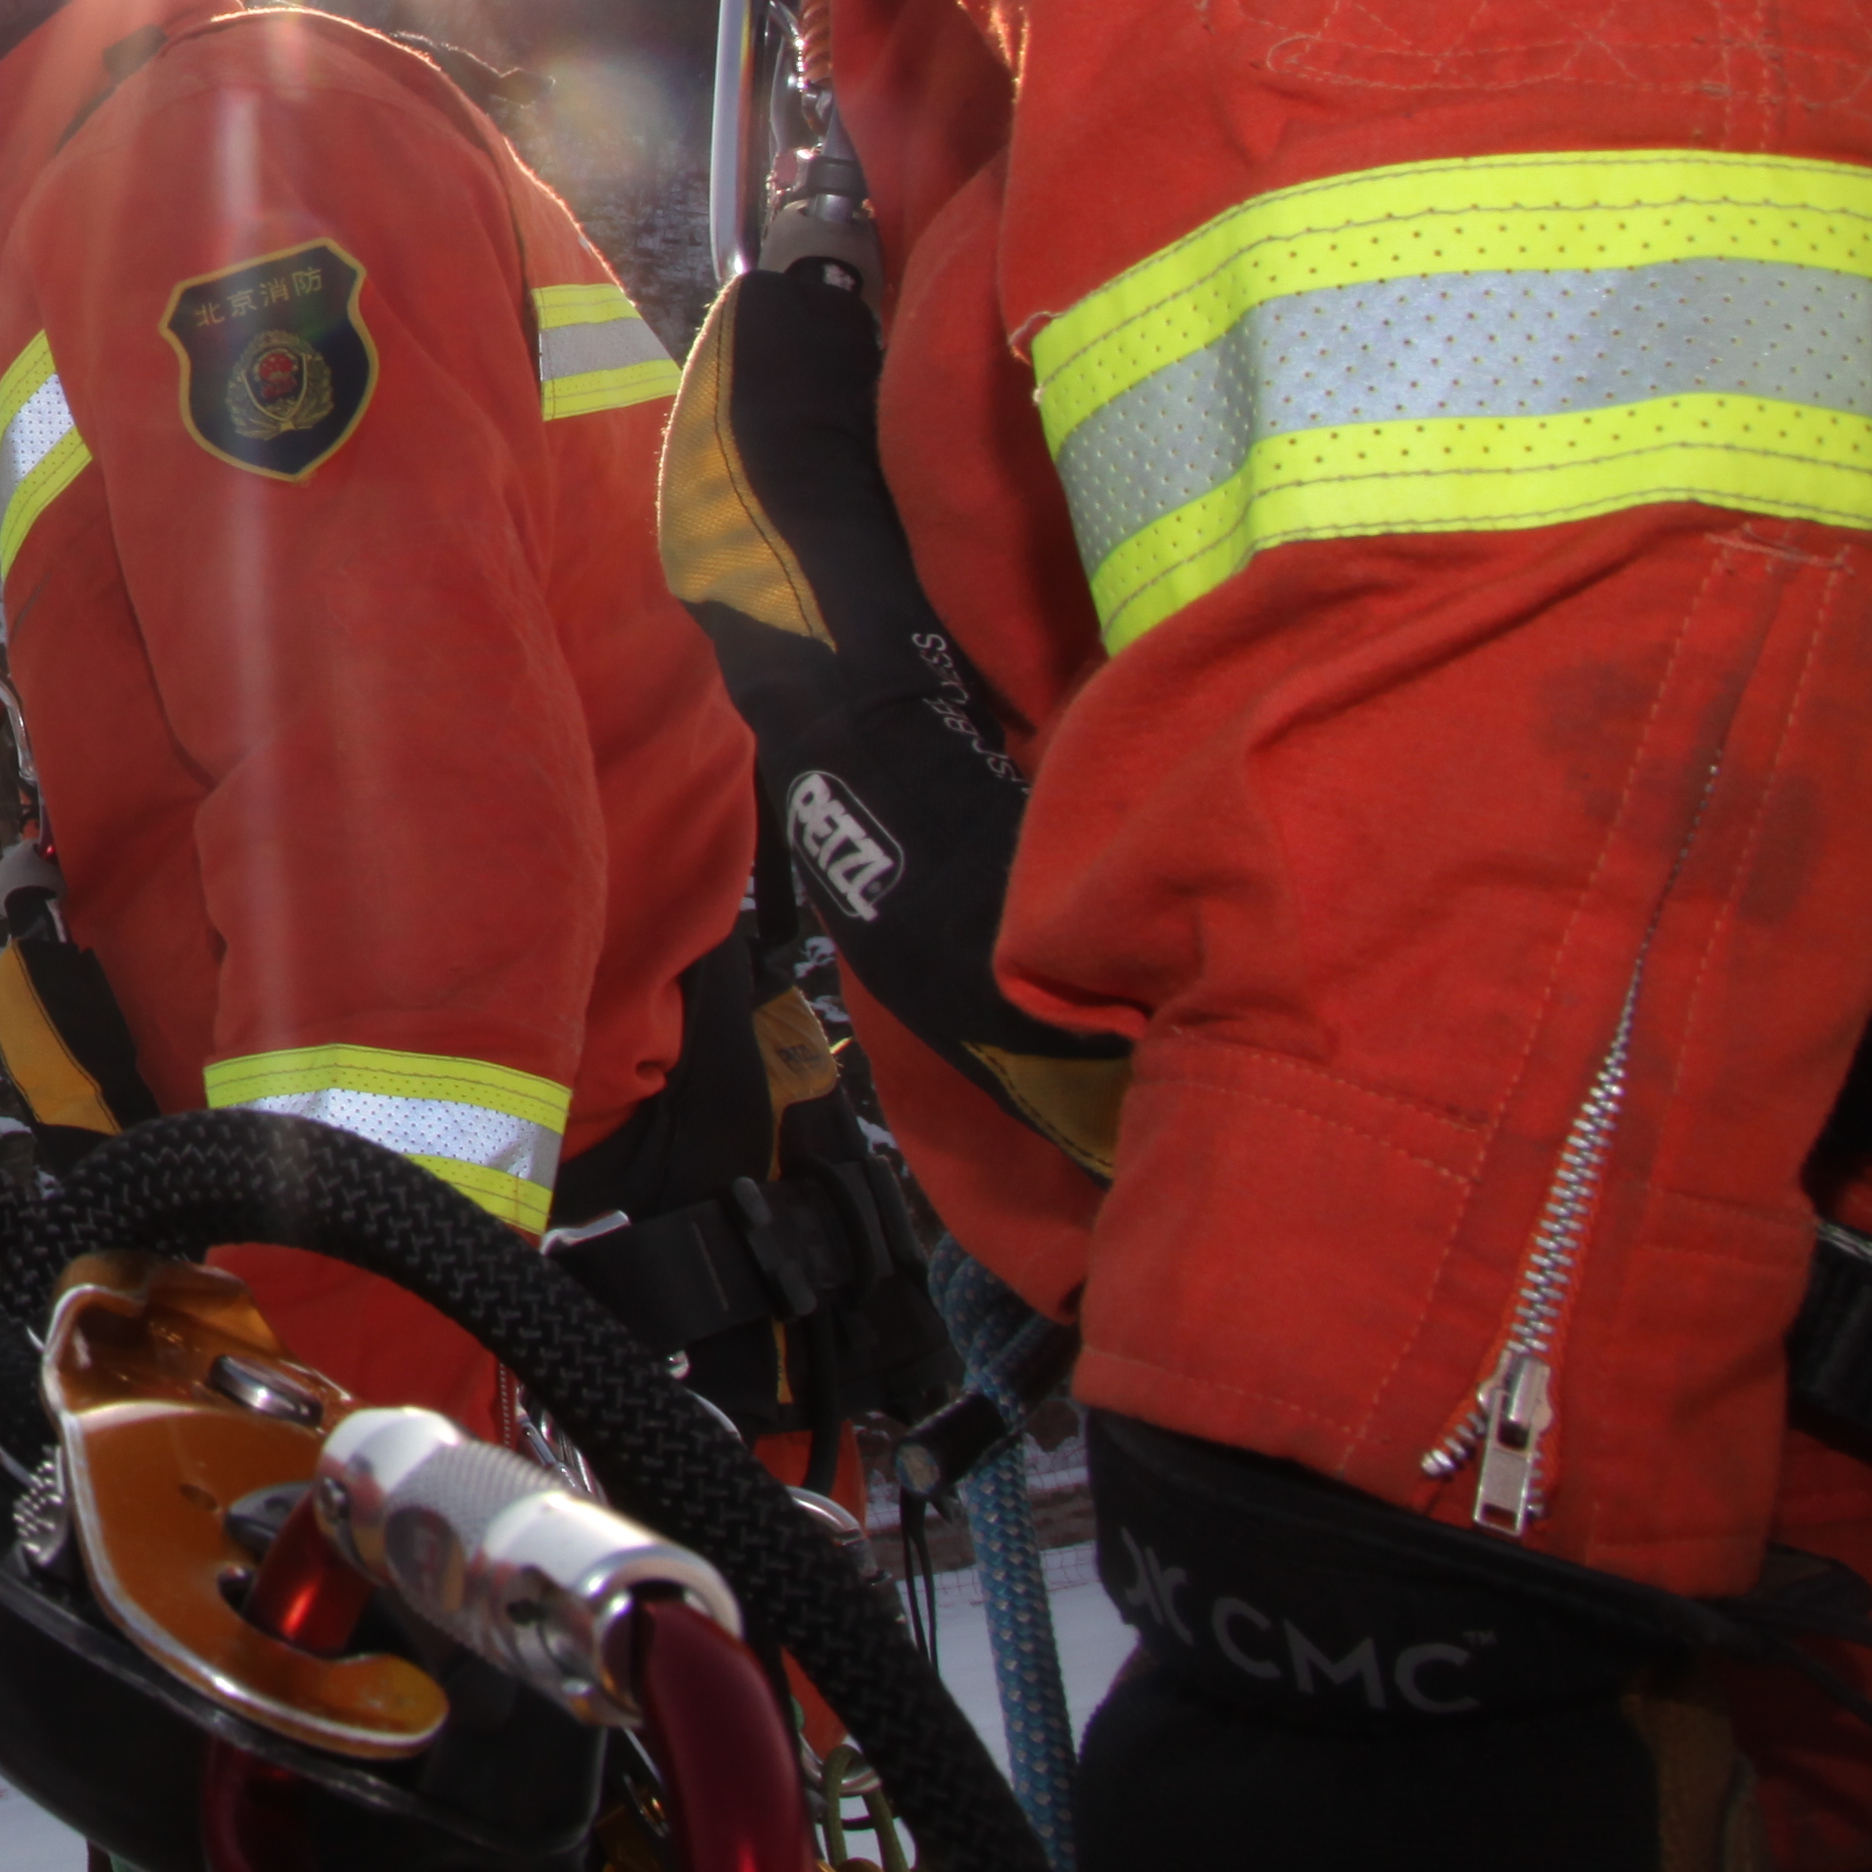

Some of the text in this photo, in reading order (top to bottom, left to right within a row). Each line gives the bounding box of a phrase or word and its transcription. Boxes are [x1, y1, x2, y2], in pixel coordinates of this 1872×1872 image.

[194, 265, 324, 327] 北京消防
[786, 772, 895, 922] PETZL
